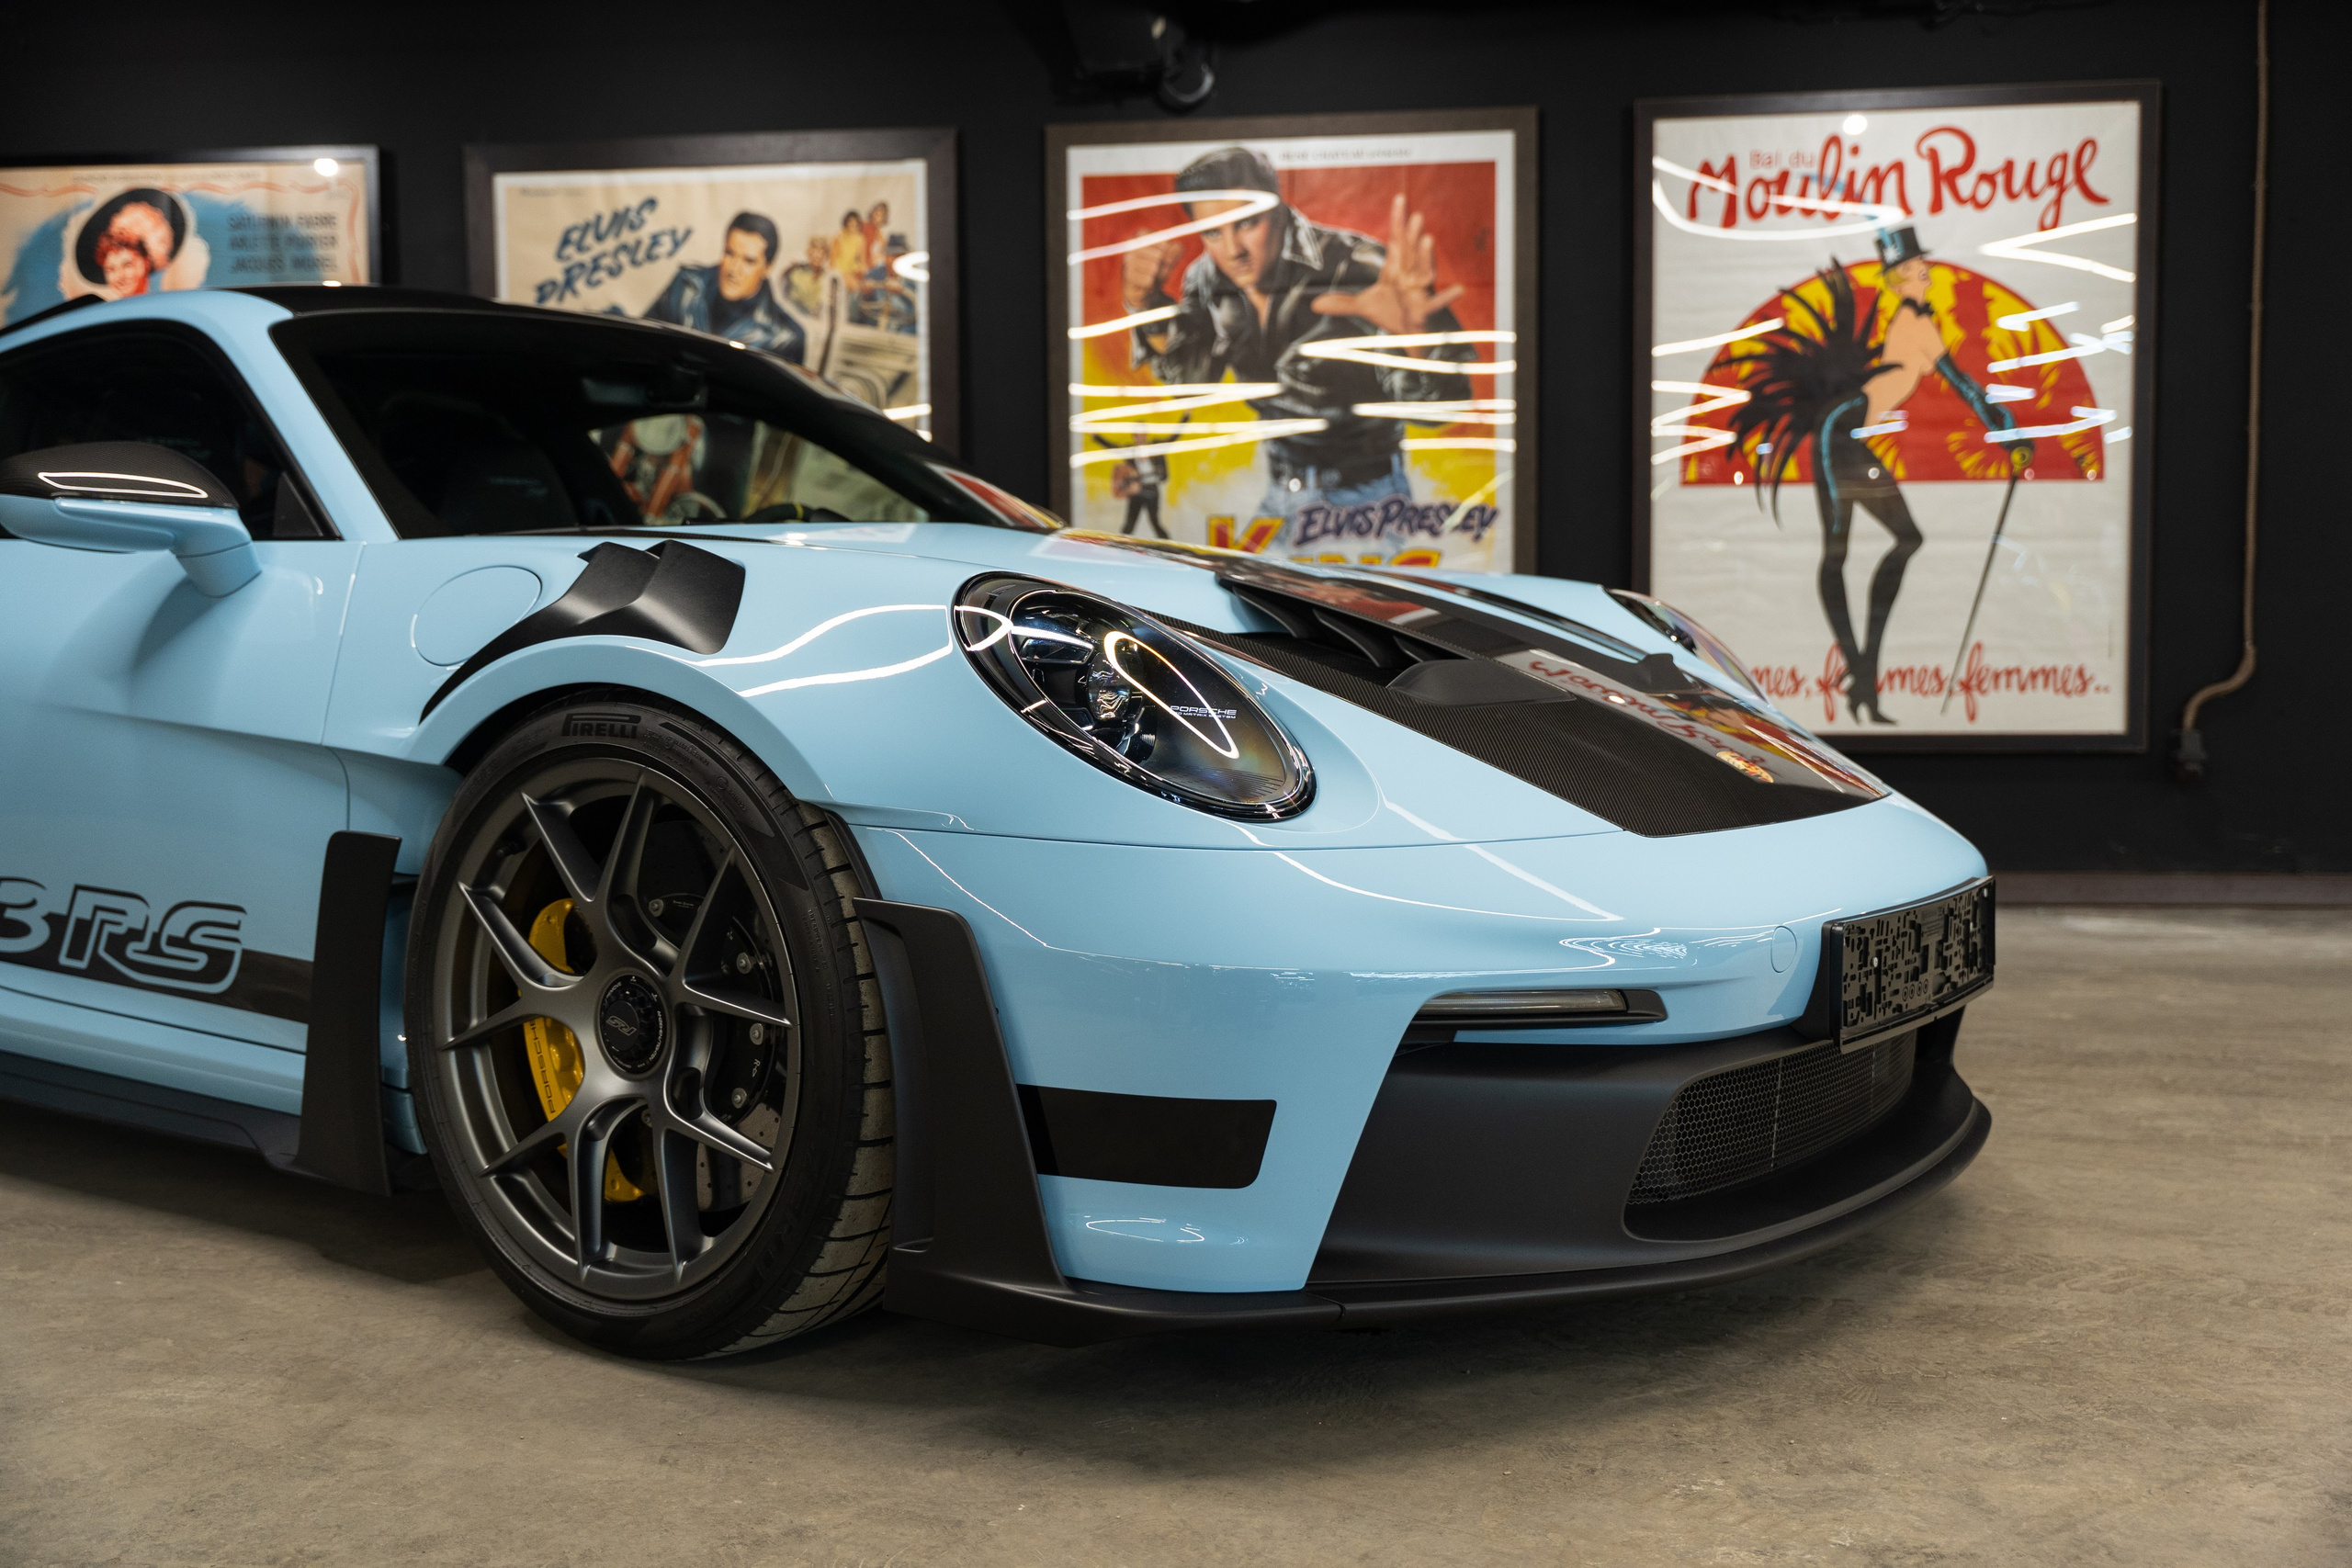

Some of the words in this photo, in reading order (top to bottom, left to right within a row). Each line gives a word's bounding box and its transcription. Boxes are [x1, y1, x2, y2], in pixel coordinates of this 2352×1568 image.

[1687, 134, 1913, 229] Moulin
[1915, 125, 2110, 231] Rouge
[1749, 150, 1781, 169] Bal
[1788, 148, 1815, 168] du
[556, 196, 658, 263] ELVIS
[560, 712, 641, 739] PIRELLI
